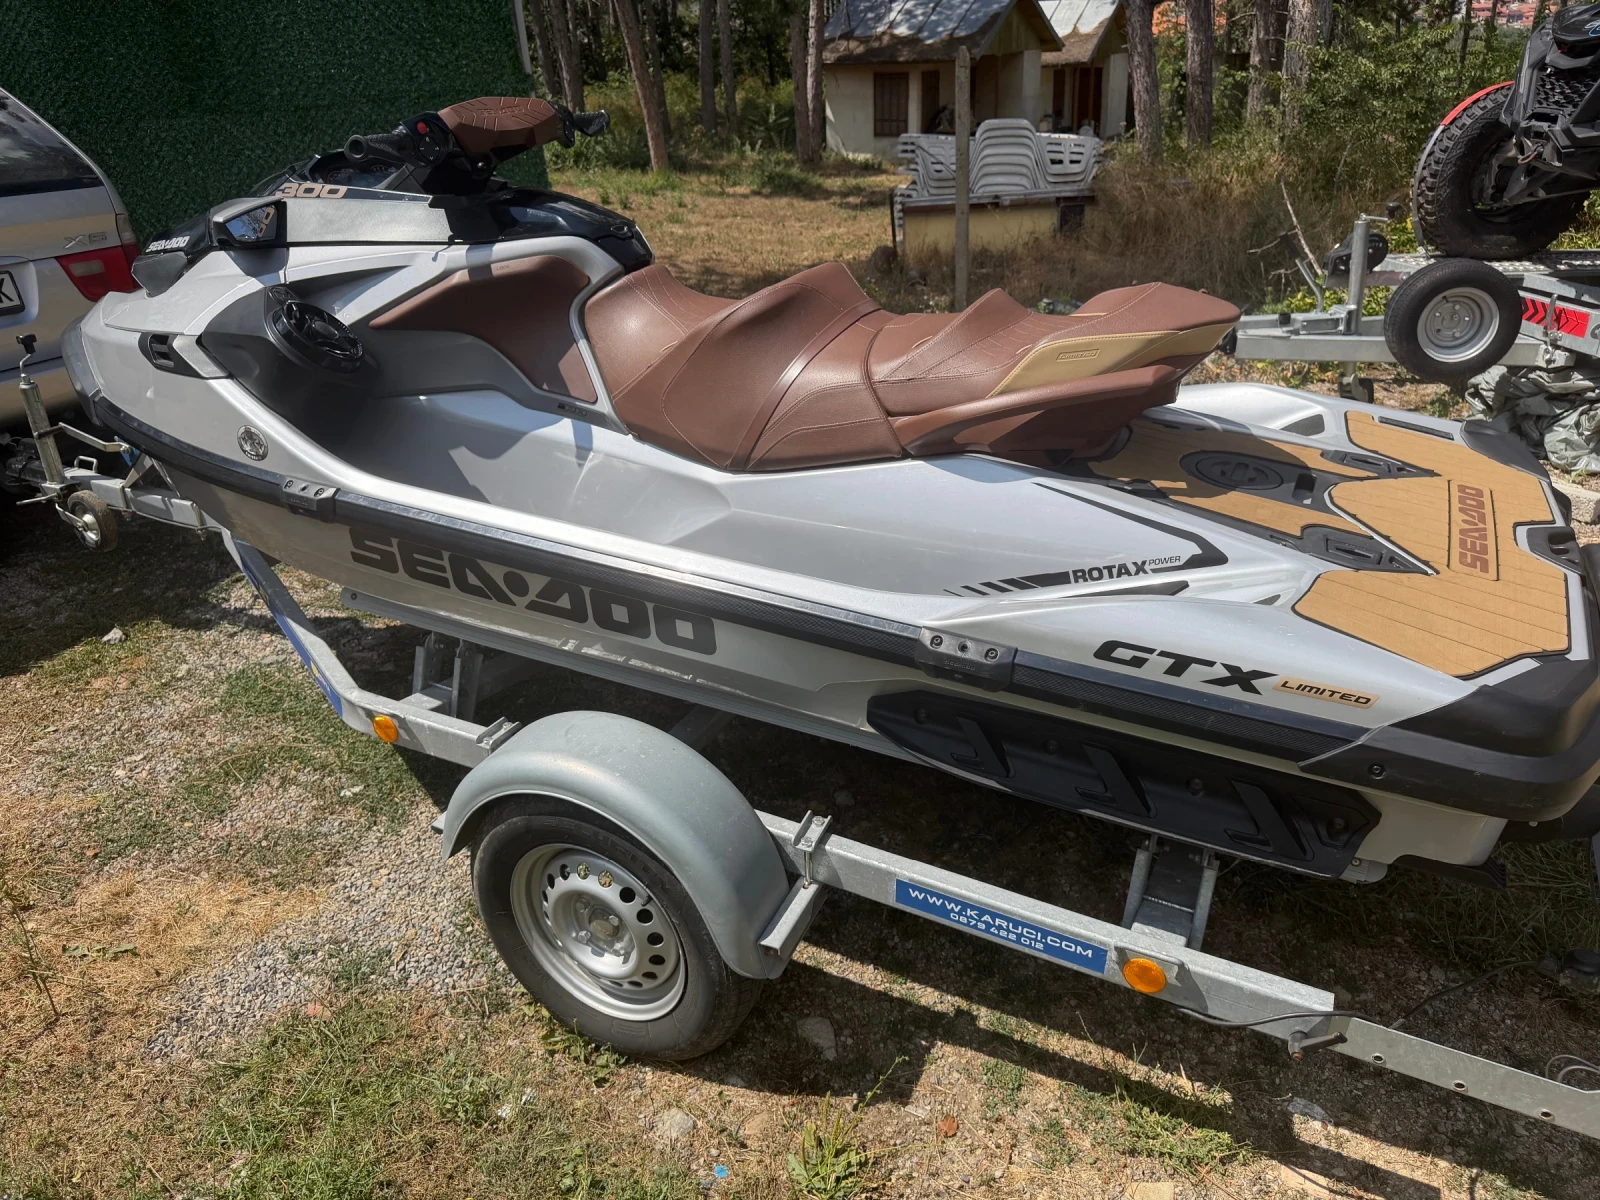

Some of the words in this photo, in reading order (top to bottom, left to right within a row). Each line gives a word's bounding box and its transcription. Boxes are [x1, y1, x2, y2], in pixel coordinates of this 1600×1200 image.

[275, 182, 348, 199] 300
[1071, 559, 1149, 584] ROTAX
[1148, 555, 1181, 567] POWER
[1093, 639, 1278, 696] GTX
[1280, 679, 1372, 706] LIMITED
[908, 888, 1093, 959] WWW.KARUCI.COM
[950, 912, 986, 930] 0879
[989, 926, 1017, 941] 422
[1020, 936, 1044, 950] 012
